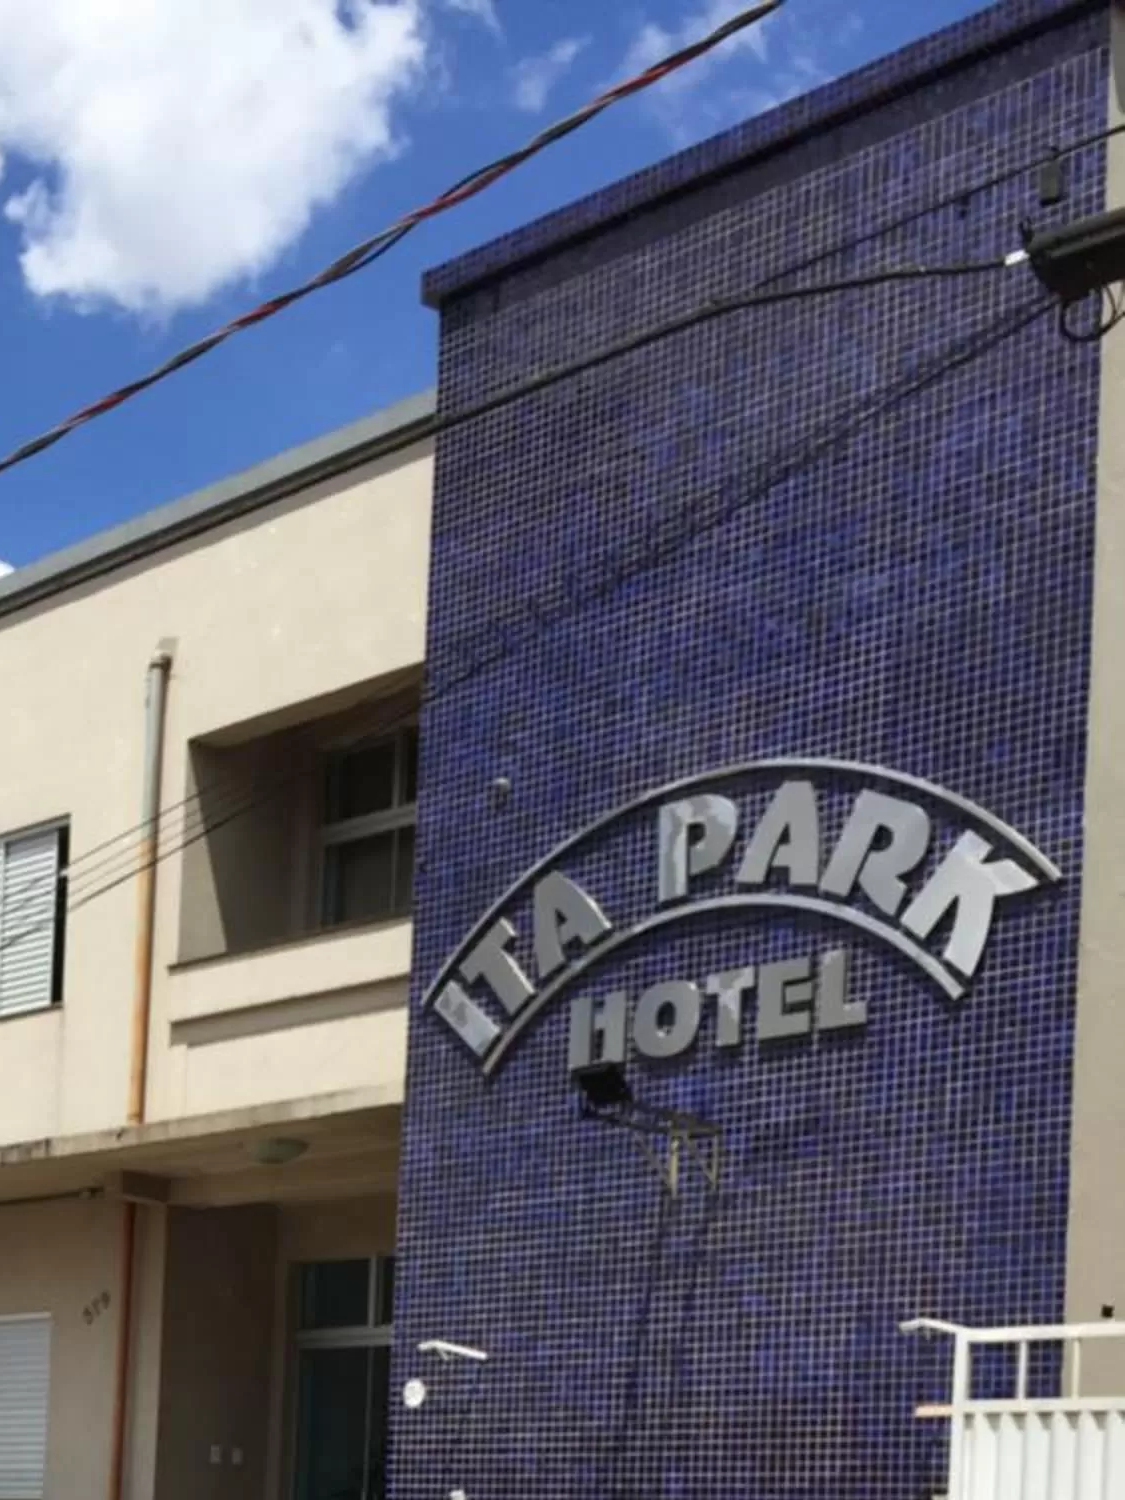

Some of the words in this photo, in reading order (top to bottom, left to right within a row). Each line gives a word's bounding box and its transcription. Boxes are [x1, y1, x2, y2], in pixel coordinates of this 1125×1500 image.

[432, 869, 613, 1058] ITA
[657, 779, 1040, 979] PARK
[567, 949, 867, 1071] HOTEL
